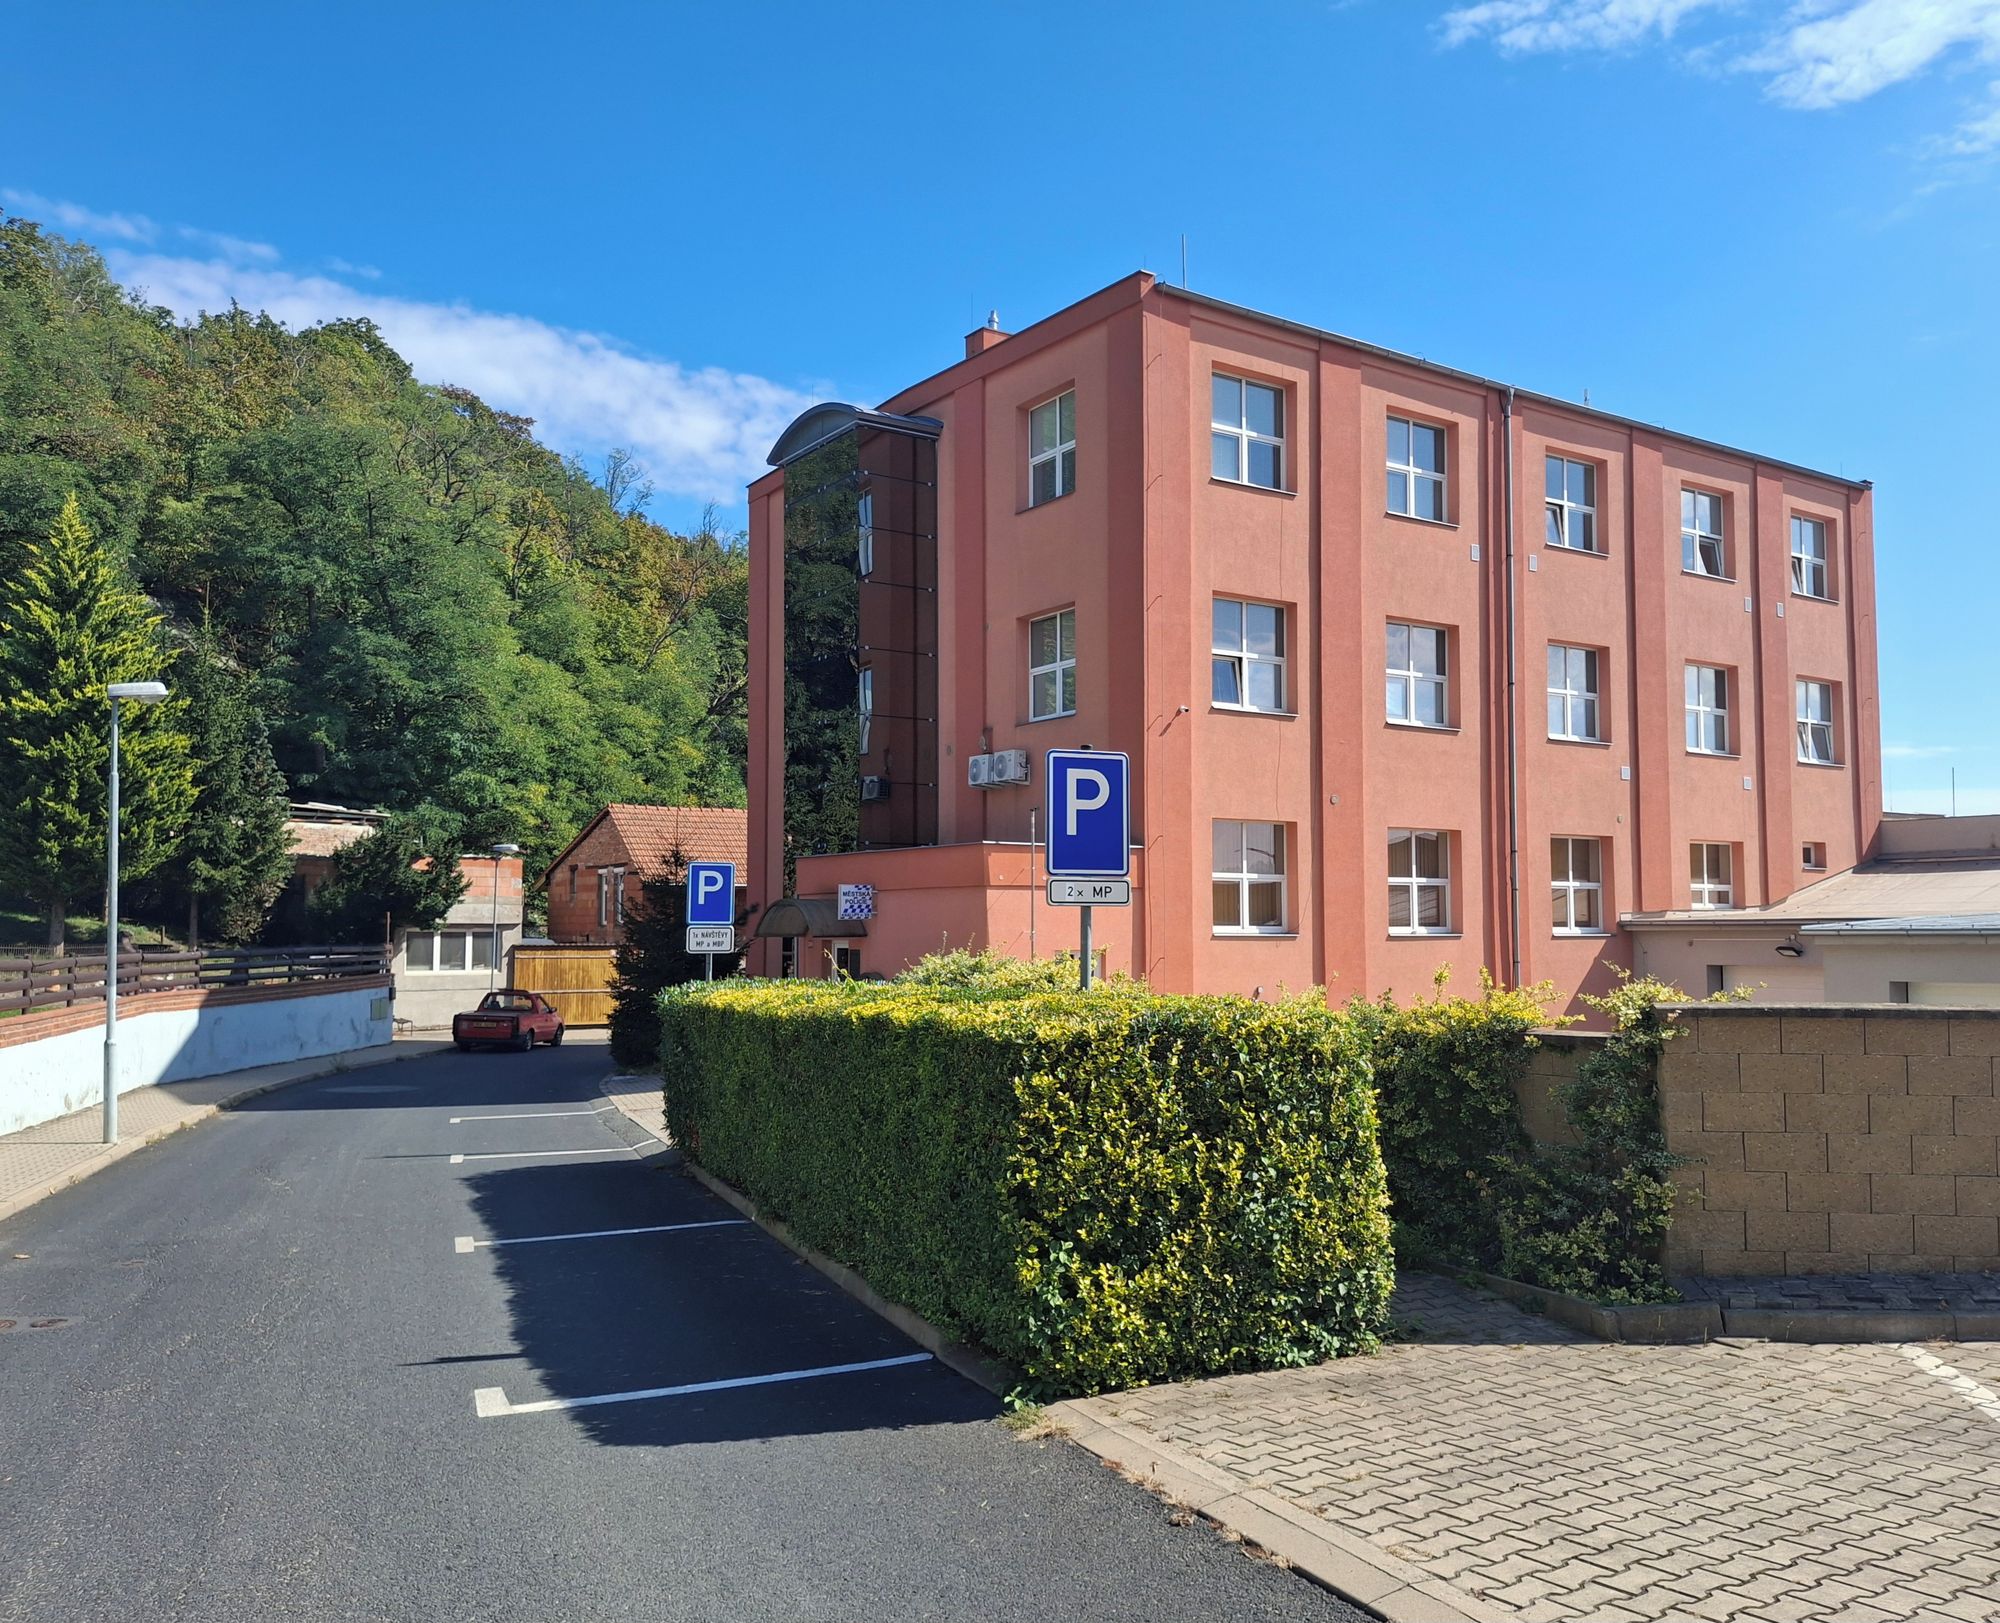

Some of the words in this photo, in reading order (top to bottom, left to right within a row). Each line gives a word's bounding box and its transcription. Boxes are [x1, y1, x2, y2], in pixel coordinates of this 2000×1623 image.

[1066, 768, 1110, 836] P
[698, 870, 724, 905] P
[1092, 886, 1113, 898] MP
[695, 940, 705, 948] MP
